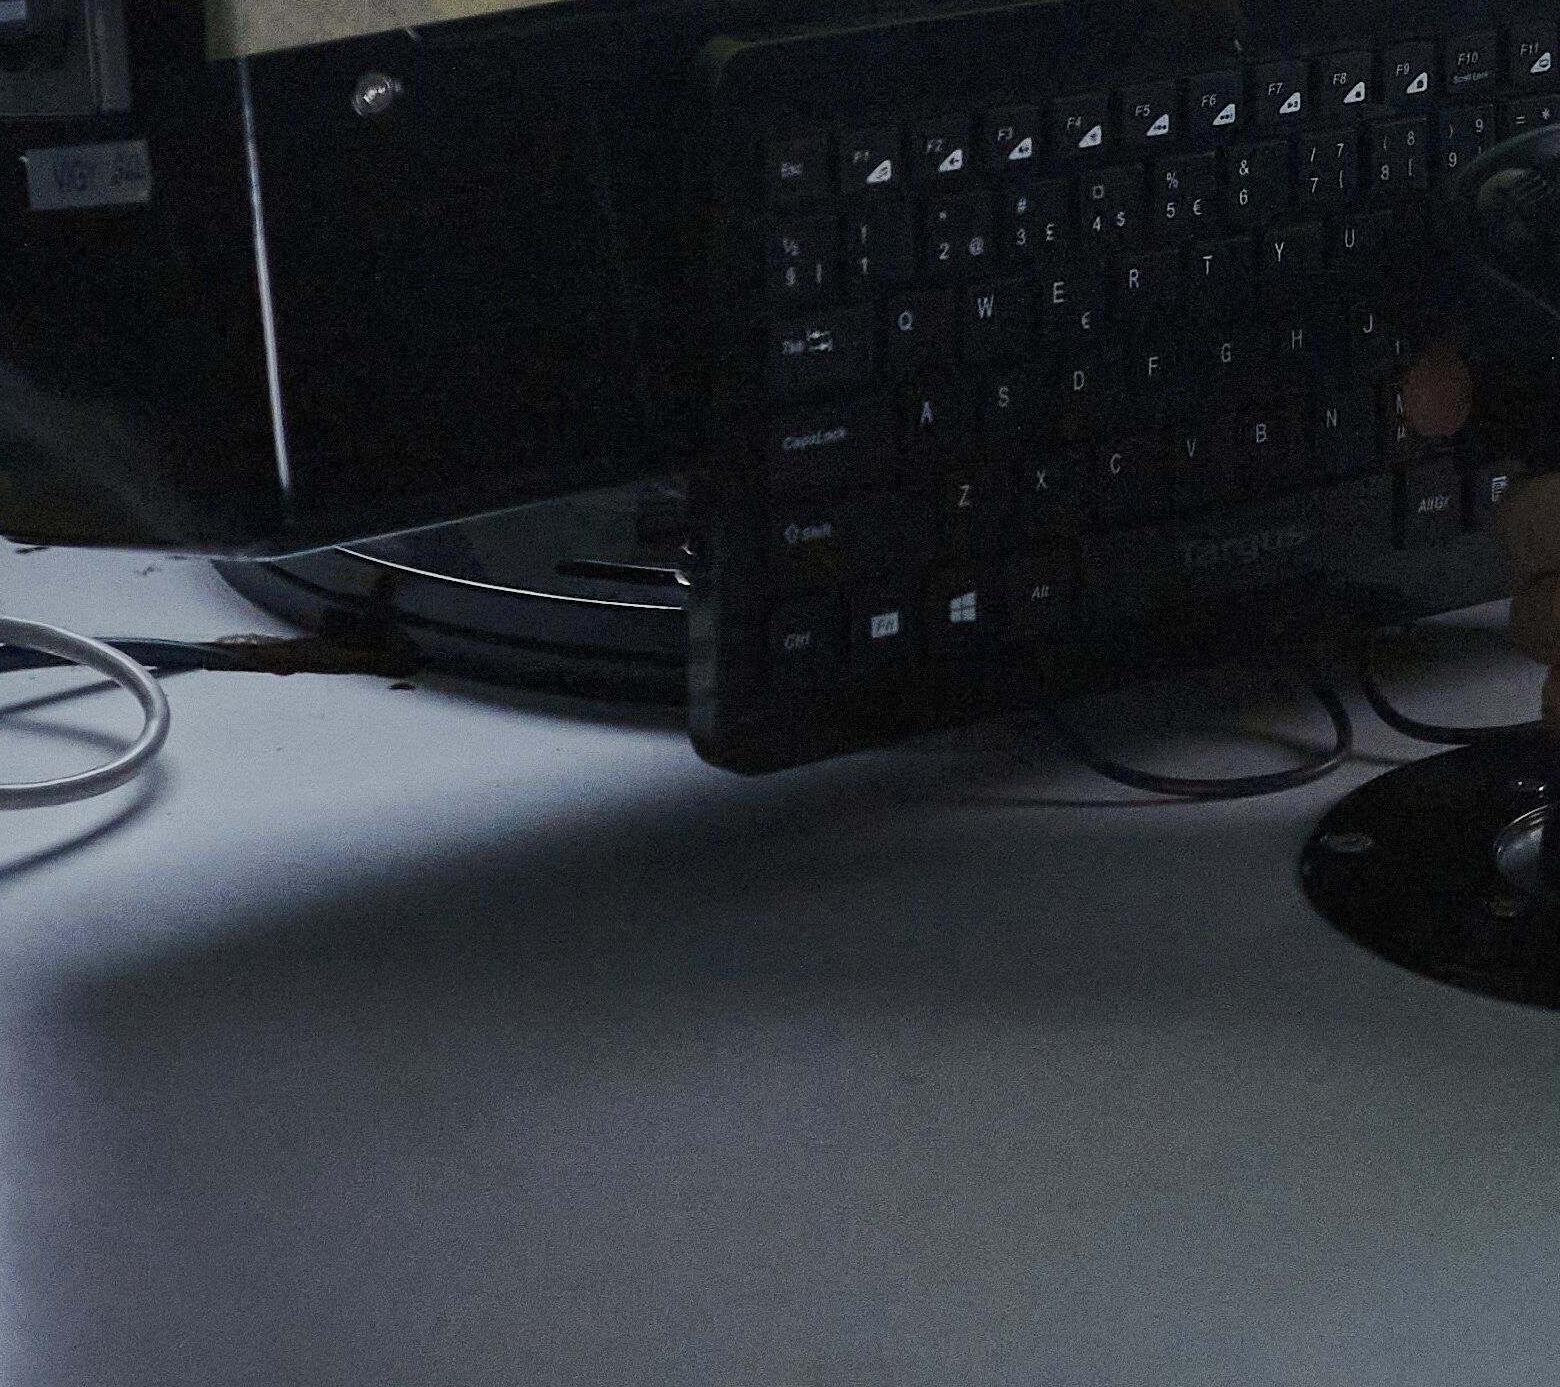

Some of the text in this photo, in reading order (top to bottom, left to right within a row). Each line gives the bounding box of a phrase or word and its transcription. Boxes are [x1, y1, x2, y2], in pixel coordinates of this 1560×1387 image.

[1457, 51, 1479, 66] F10
[1520, 42, 1540, 56] F11
[1332, 71, 1348, 85] F8
[1395, 62, 1411, 76] F9
[1267, 81, 1284, 96] F7
[1200, 93, 1217, 108] F6
[1474, 117, 1484, 133] 9
[1406, 130, 1416, 147] 8
[1336, 142, 1345, 157] 7
[1448, 151, 1458, 168] 9
[1238, 159, 1250, 176] &
[1379, 164, 1390, 181] 8
[1310, 176, 1320, 193] 7
[1238, 188, 1249, 206] 6
[1166, 201, 1176, 219] 5
[1092, 216, 1102, 231] 4
[1016, 227, 1027, 246] 3
[1344, 228, 1356, 249] U
[938, 242, 950, 260] 2
[1274, 241, 1285, 262] Y
[1202, 254, 1213, 275] T
[1128, 268, 1140, 289] R
[1052, 281, 1065, 304] E
[977, 294, 995, 319] W
[898, 310, 913, 331] Q
[1362, 314, 1374, 334] J
[1290, 328, 1303, 349] H
[1220, 342, 1232, 364] G
[1147, 355, 1159, 376] F
[1072, 370, 1086, 391] D
[997, 385, 1010, 408] S
[920, 401, 934, 424] A
[1326, 408, 1338, 428] N
[1255, 422, 1268, 444] B
[1185, 438, 1197, 458] V
[1109, 452, 1122, 475] C
[1036, 469, 1048, 490] X
[957, 484, 971, 508] Z
